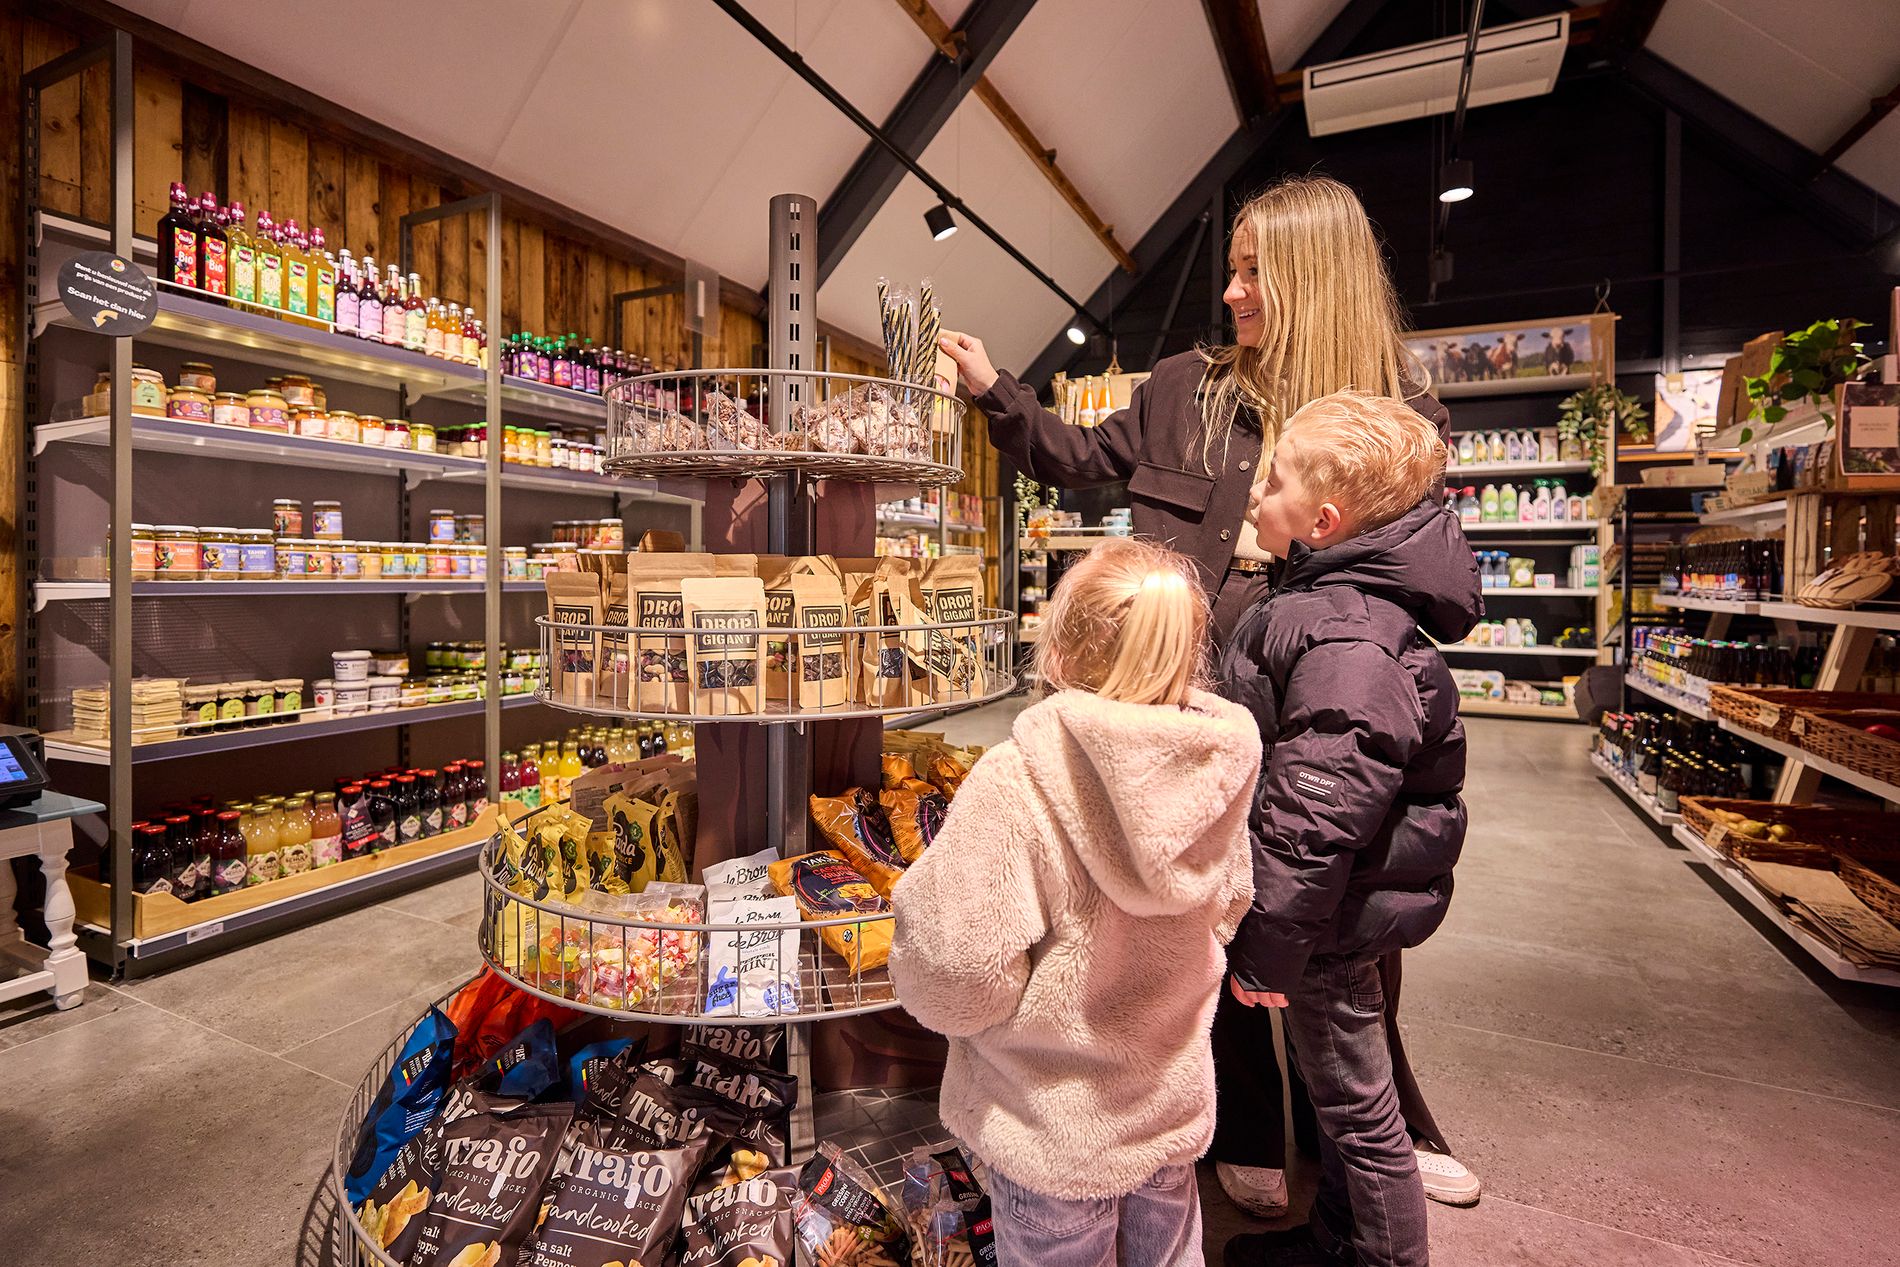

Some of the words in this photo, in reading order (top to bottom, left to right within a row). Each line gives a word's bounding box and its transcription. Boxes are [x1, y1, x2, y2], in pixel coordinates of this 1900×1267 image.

[76, 272, 92, 282] prijs
[92, 278, 105, 286] van
[105, 283, 117, 291] een
[117, 287, 147, 302] product?
[97, 271, 128, 288] benieuwd
[127, 283, 143, 293] naar
[142, 289, 152, 297] de
[67, 286, 92, 301] Scan
[93, 295, 110, 308] het
[110, 302, 128, 315] dan
[128, 308, 147, 320] hier
[643, 599, 682, 616] DRO
[940, 595, 973, 610] DROP
[643, 615, 684, 629] GIGAN
[701, 617, 752, 629] DROP
[810, 612, 840, 628] DROP
[943, 609, 974, 621] GIGANT
[702, 634, 752, 646] GIGANT
[1299, 771, 1320, 783] OTWR
[1319, 778, 1336, 788] DPT
[732, 958, 778, 974] MINT
[685, 1024, 761, 1060] Trafo
[817, 1171, 833, 1194] PAOLO
[569, 1184, 620, 1203] ORGANIC
[831, 1182, 849, 1207] GRISSINI
[838, 1190, 851, 1207] CORTI
[549, 1202, 658, 1242] andcooked
[975, 1220, 992, 1233] PAO
[422, 1226, 441, 1240] salt
[864, 1227, 872, 1240] BIO
[417, 1239, 440, 1256] epper
[536, 1240, 548, 1251] ea
[549, 1243, 573, 1258] salt
[979, 1241, 996, 1256] GRISS
